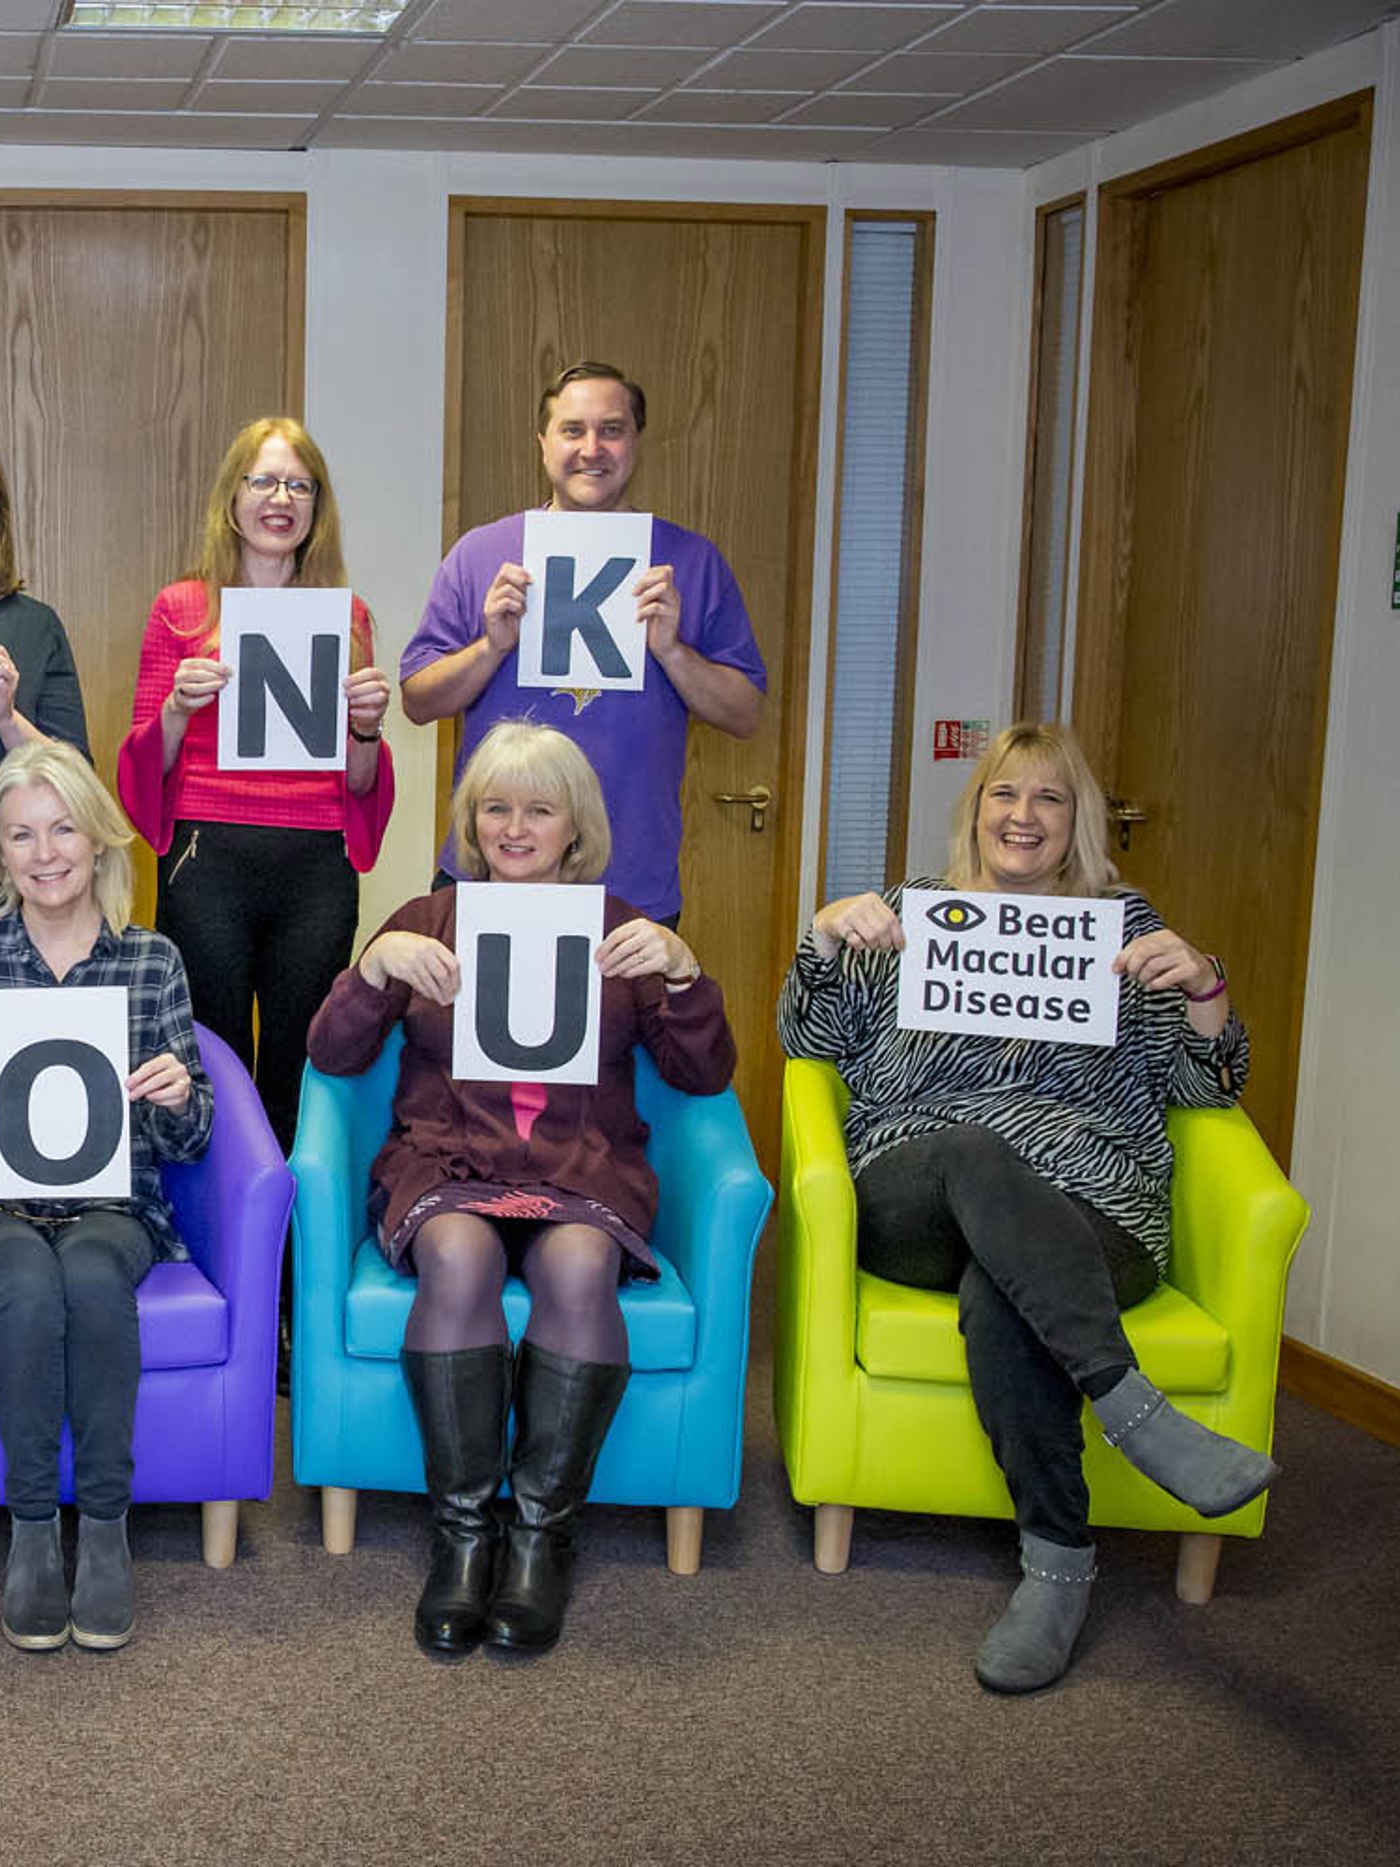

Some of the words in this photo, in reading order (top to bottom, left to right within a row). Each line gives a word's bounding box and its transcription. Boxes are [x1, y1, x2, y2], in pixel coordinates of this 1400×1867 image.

[541, 556, 636, 679] K
[238, 634, 341, 758] N
[926, 938, 1096, 980] Macular
[998, 903, 1096, 941] Beat
[475, 933, 590, 1071] U
[923, 979, 1091, 1023] Disease
